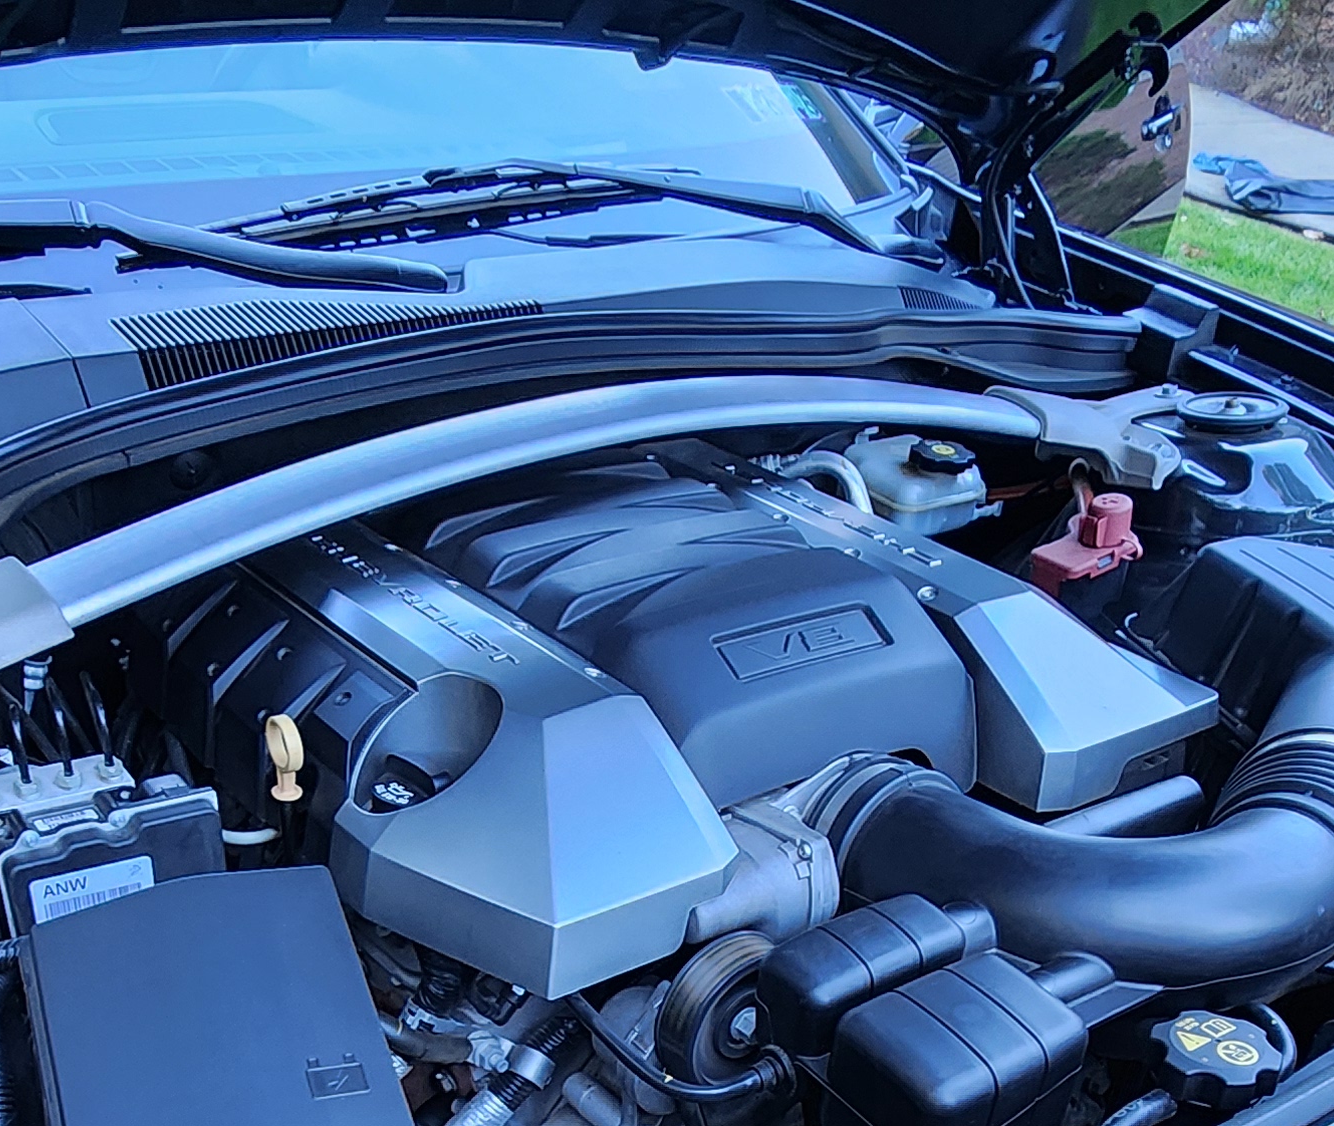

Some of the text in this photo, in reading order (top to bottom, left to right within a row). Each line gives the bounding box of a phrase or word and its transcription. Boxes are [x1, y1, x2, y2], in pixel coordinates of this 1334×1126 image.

[311, 535, 521, 666] CHEVROLET
[744, 621, 858, 661] V8
[43, 875, 88, 900] ANW
